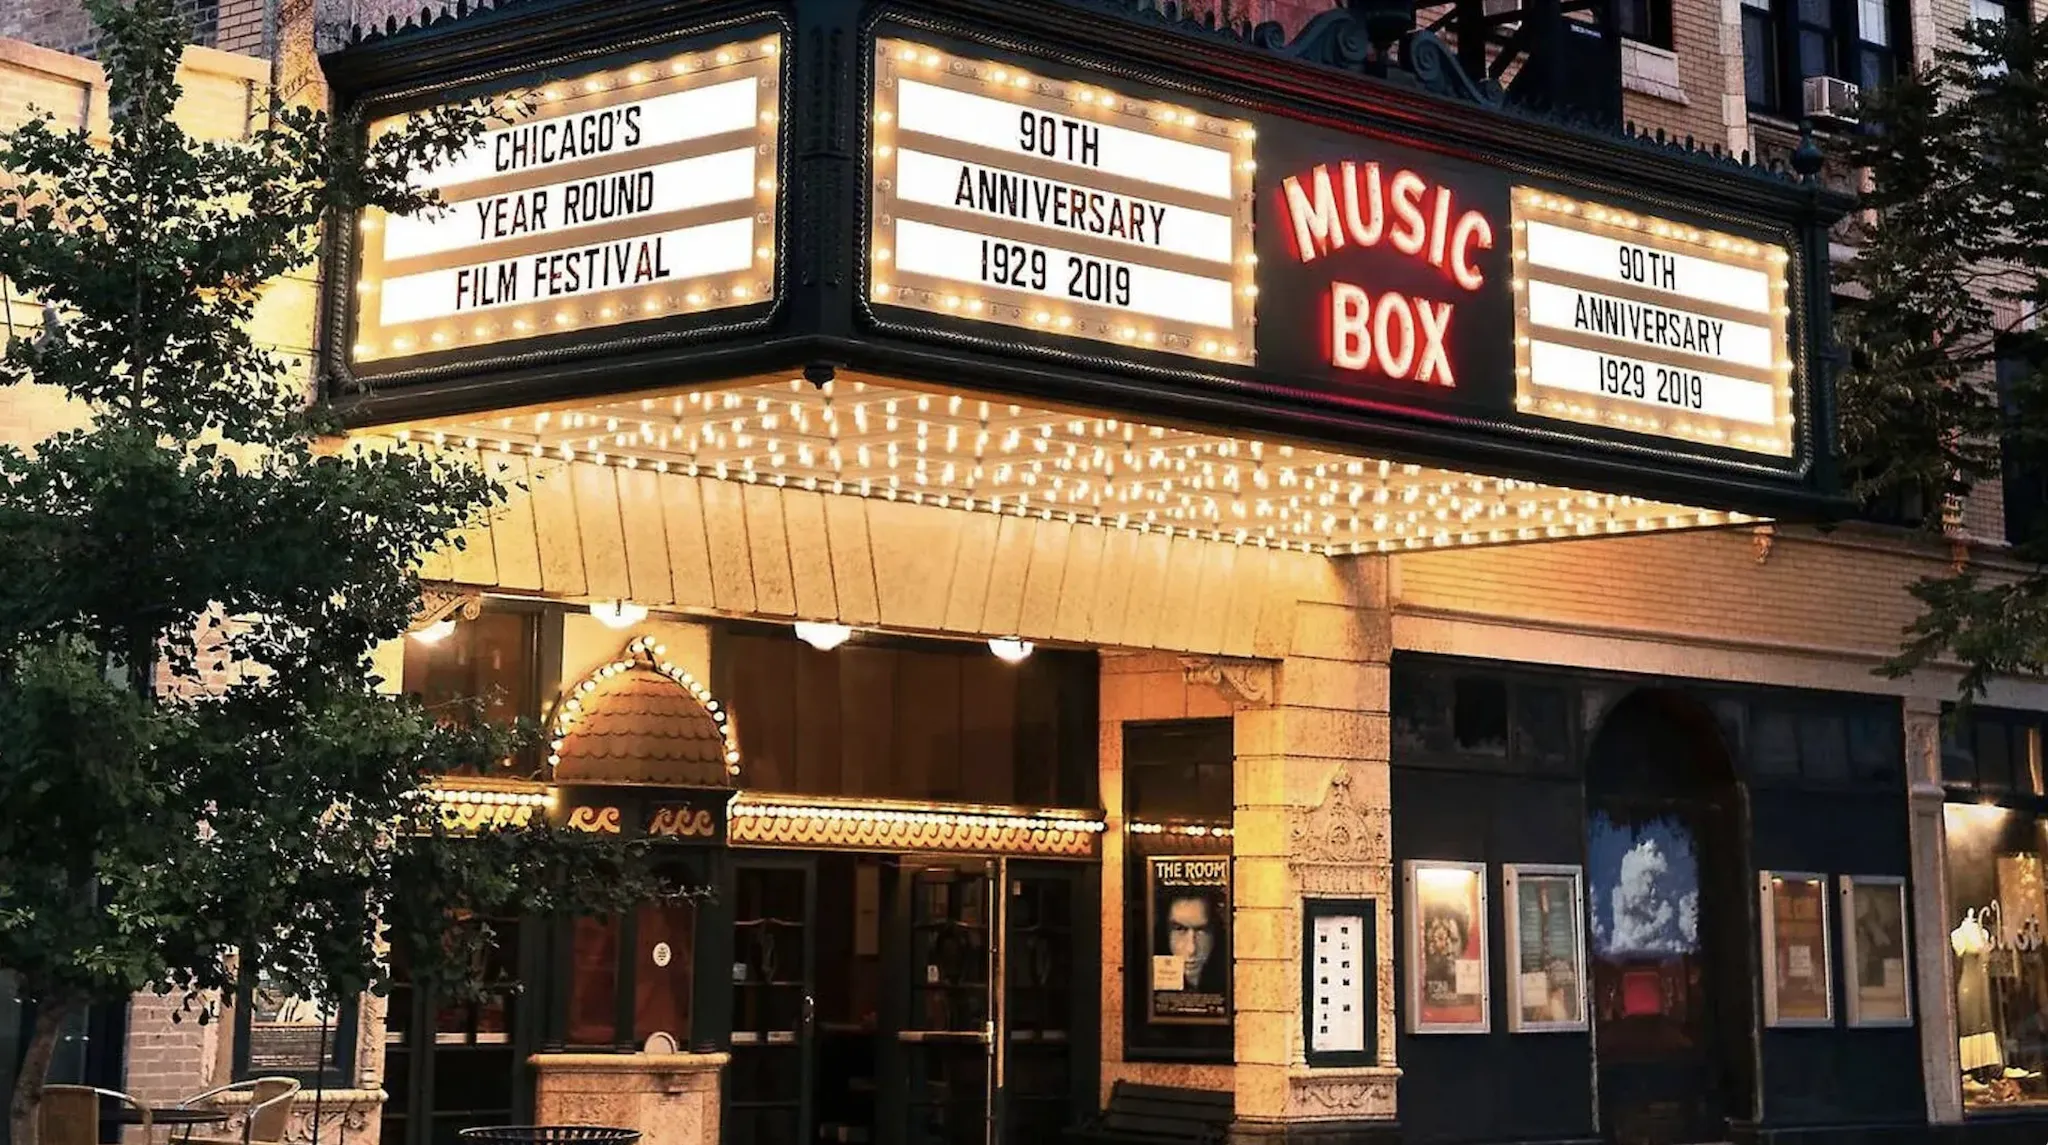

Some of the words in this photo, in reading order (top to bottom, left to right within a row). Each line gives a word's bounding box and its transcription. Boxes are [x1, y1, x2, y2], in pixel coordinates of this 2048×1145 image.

[495, 105, 642, 172] CHICAGO'S
[1020, 110, 1099, 167] 90TH
[477, 190, 548, 240] YEAR
[564, 170, 655, 226] ROUND
[955, 165, 1166, 246] ANNIVERSARY
[1282, 160, 1493, 292] MUSIC
[456, 260, 519, 310] FILM
[533, 237, 670, 298] FESTIVAL
[981, 239, 1047, 291] 1929
[1067, 256, 1131, 307] 2019
[1619, 245, 1676, 291] 90TH
[1330, 281, 1456, 388] BOX
[1574, 294, 1723, 356] ANNIVERSARY
[1599, 356, 1646, 400] 1929
[1657, 369, 1702, 409] 2019
[1155, 862, 1182, 879] THE
[1185, 862, 1226, 879] ROOM
